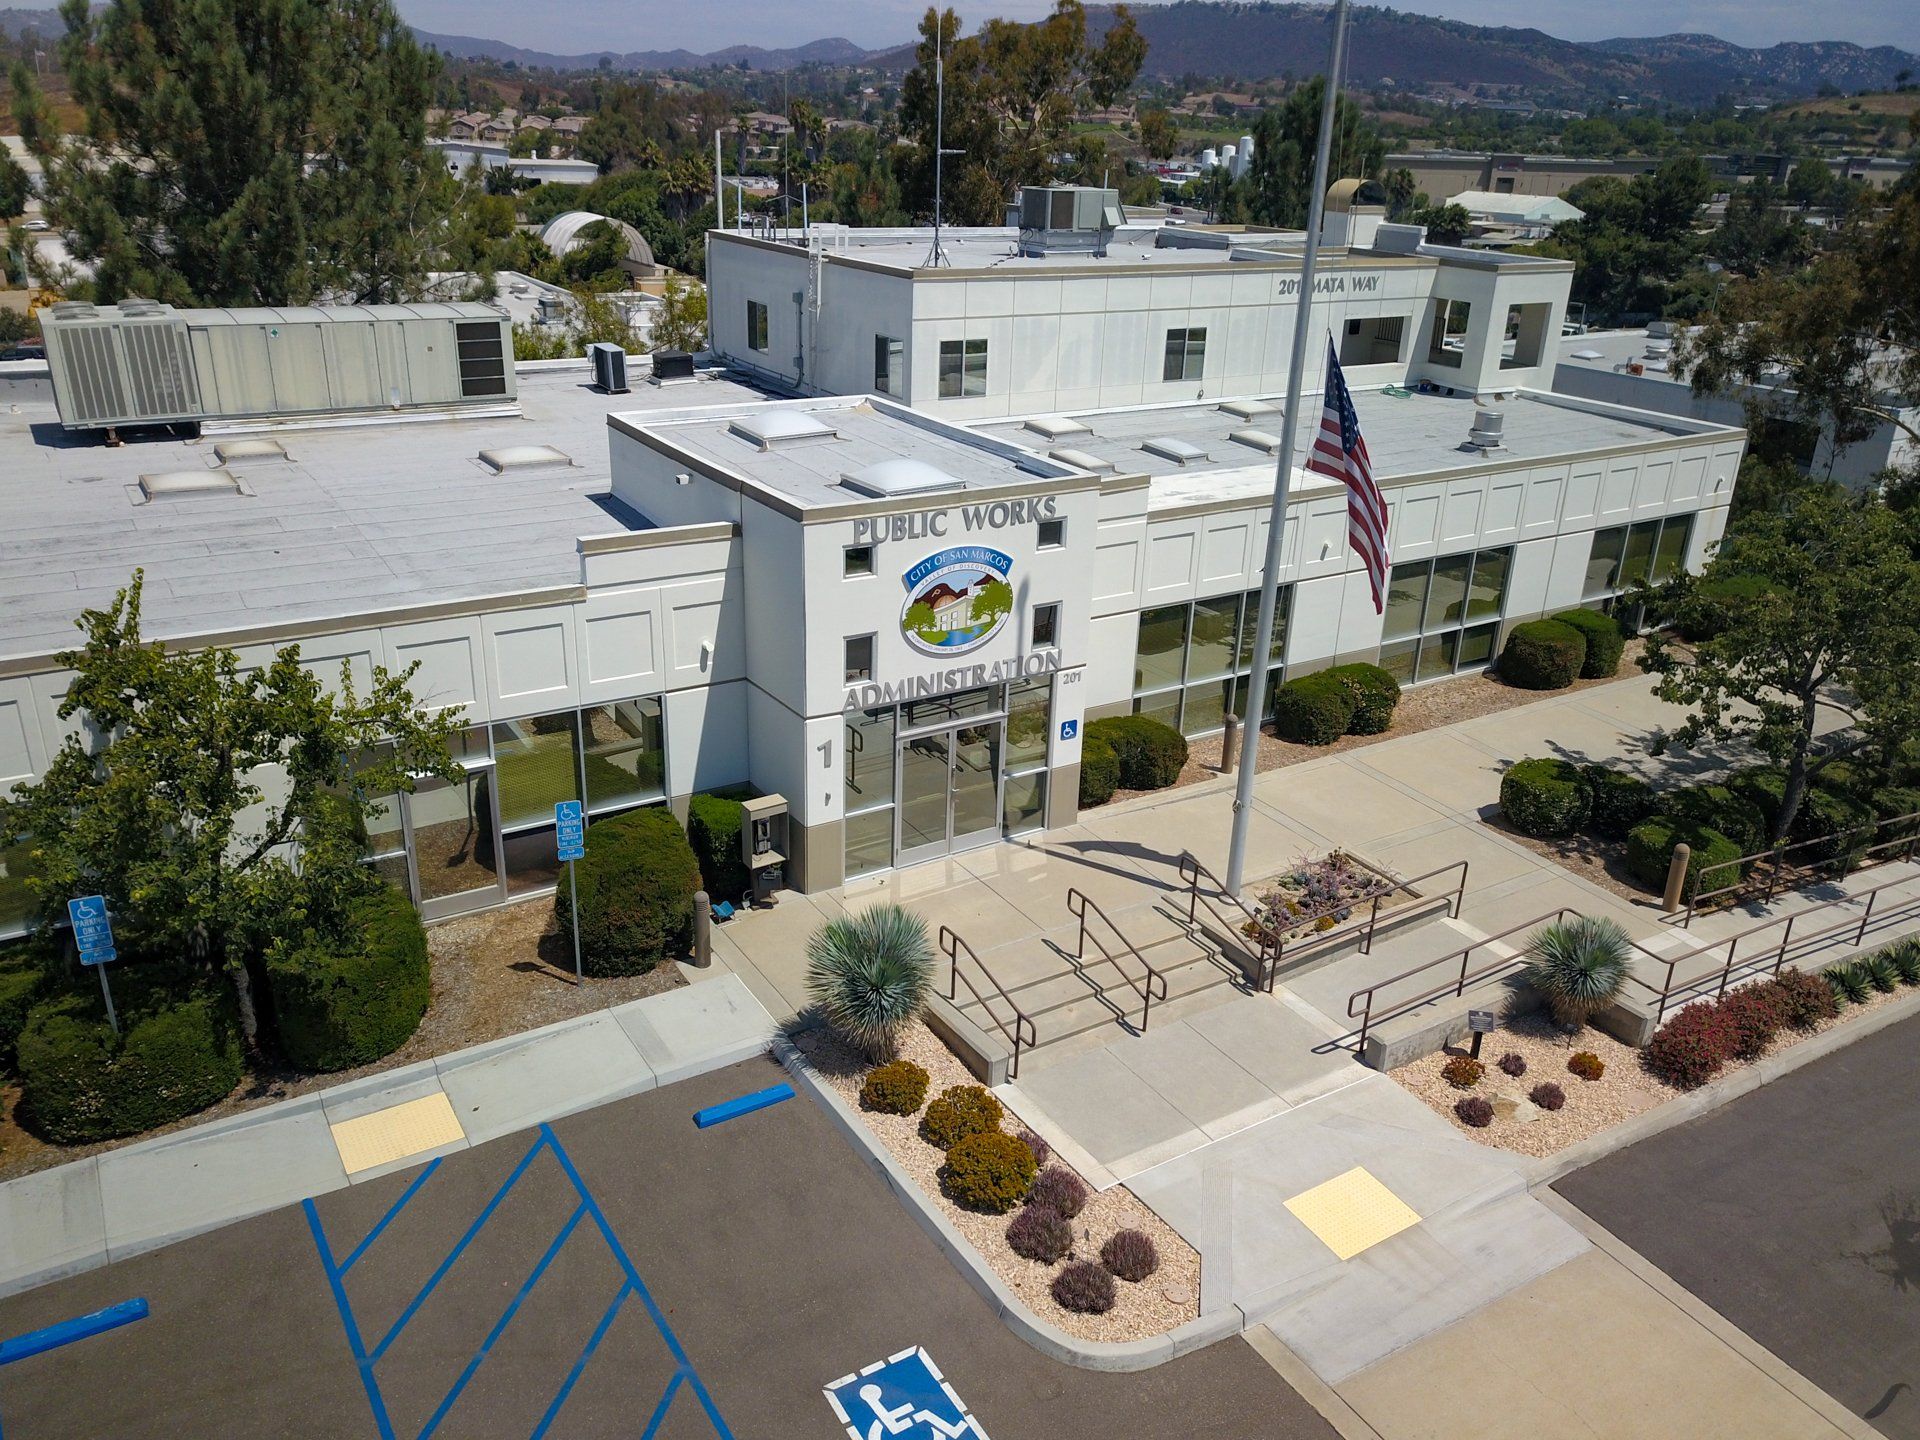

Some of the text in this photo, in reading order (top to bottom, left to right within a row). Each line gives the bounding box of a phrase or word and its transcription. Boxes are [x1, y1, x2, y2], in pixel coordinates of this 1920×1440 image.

[1311, 276, 1345, 293] MATA
[1352, 276, 1380, 292] WAY
[853, 496, 1057, 545] PUBLIC WORKS
[910, 550, 1009, 581] CITY OF SAN MARCOS
[920, 570, 944, 586] VALLEY
[959, 563, 996, 575] DISCOVERY
[842, 649, 1062, 712] ADMINISTRATION
[1063, 671, 1082, 685] 201
[557, 819, 581, 828] PARKING
[74, 915, 106, 928] PARKING
[82, 925, 101, 935] ONLY
